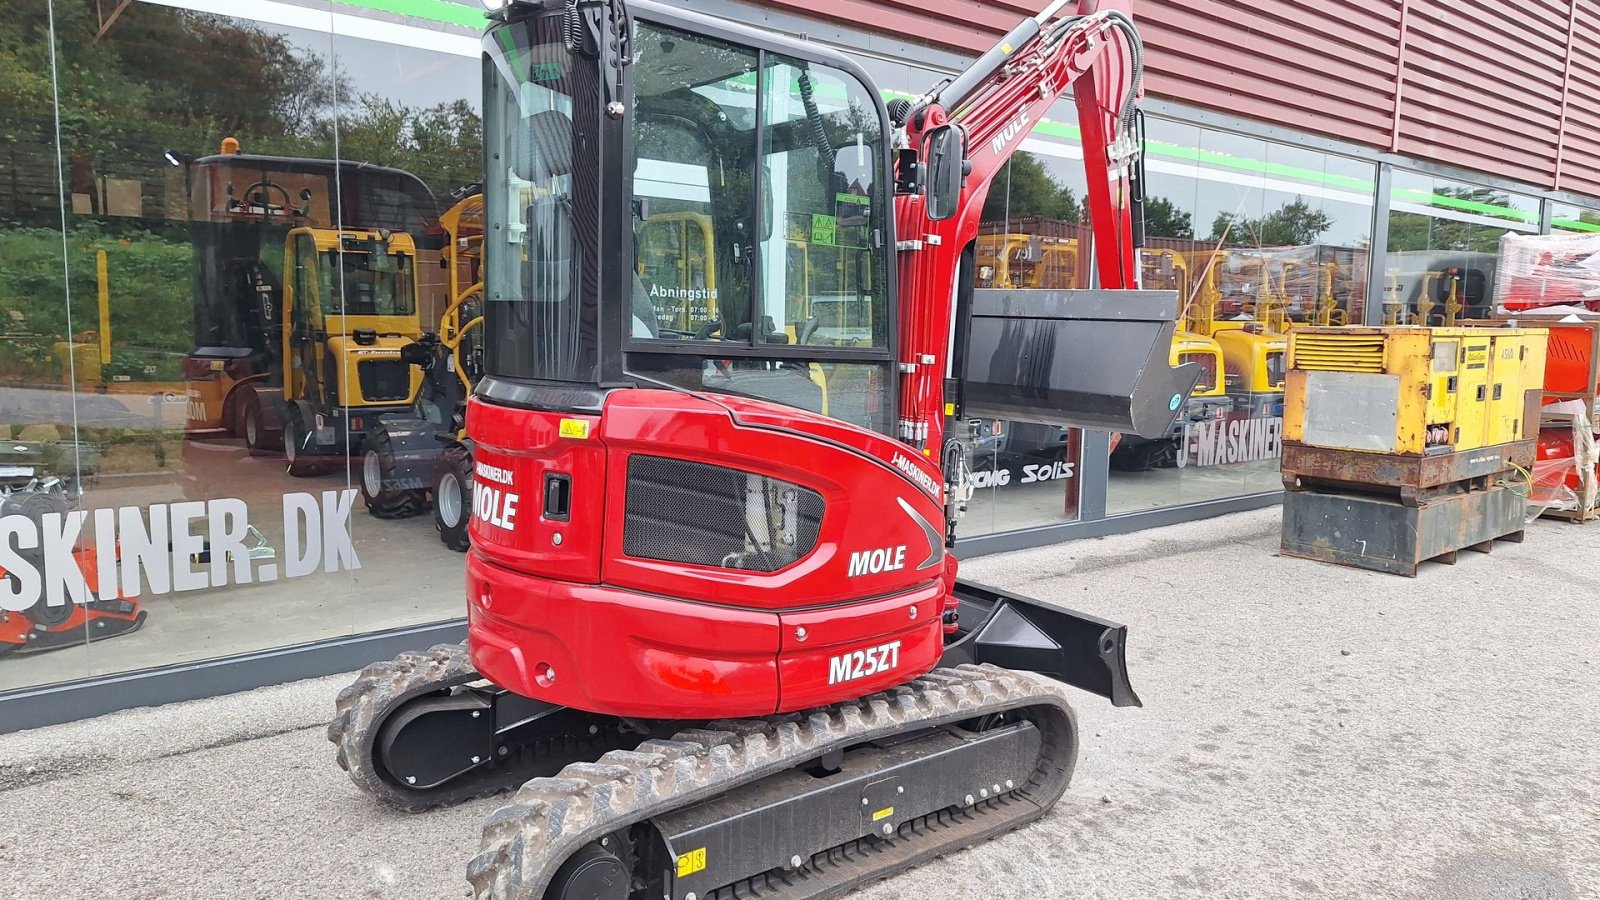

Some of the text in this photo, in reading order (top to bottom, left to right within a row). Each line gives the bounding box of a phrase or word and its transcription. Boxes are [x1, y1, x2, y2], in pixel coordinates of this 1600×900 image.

[990, 103, 1030, 155] MOLE
[143, 365, 156, 374] 20
[891, 451, 941, 499] J-MASKINER.DK
[965, 469, 1011, 489] XCMG
[472, 480, 519, 531] MOLE
[848, 545, 907, 577] MOLE
[828, 640, 901, 686] M25ZT
